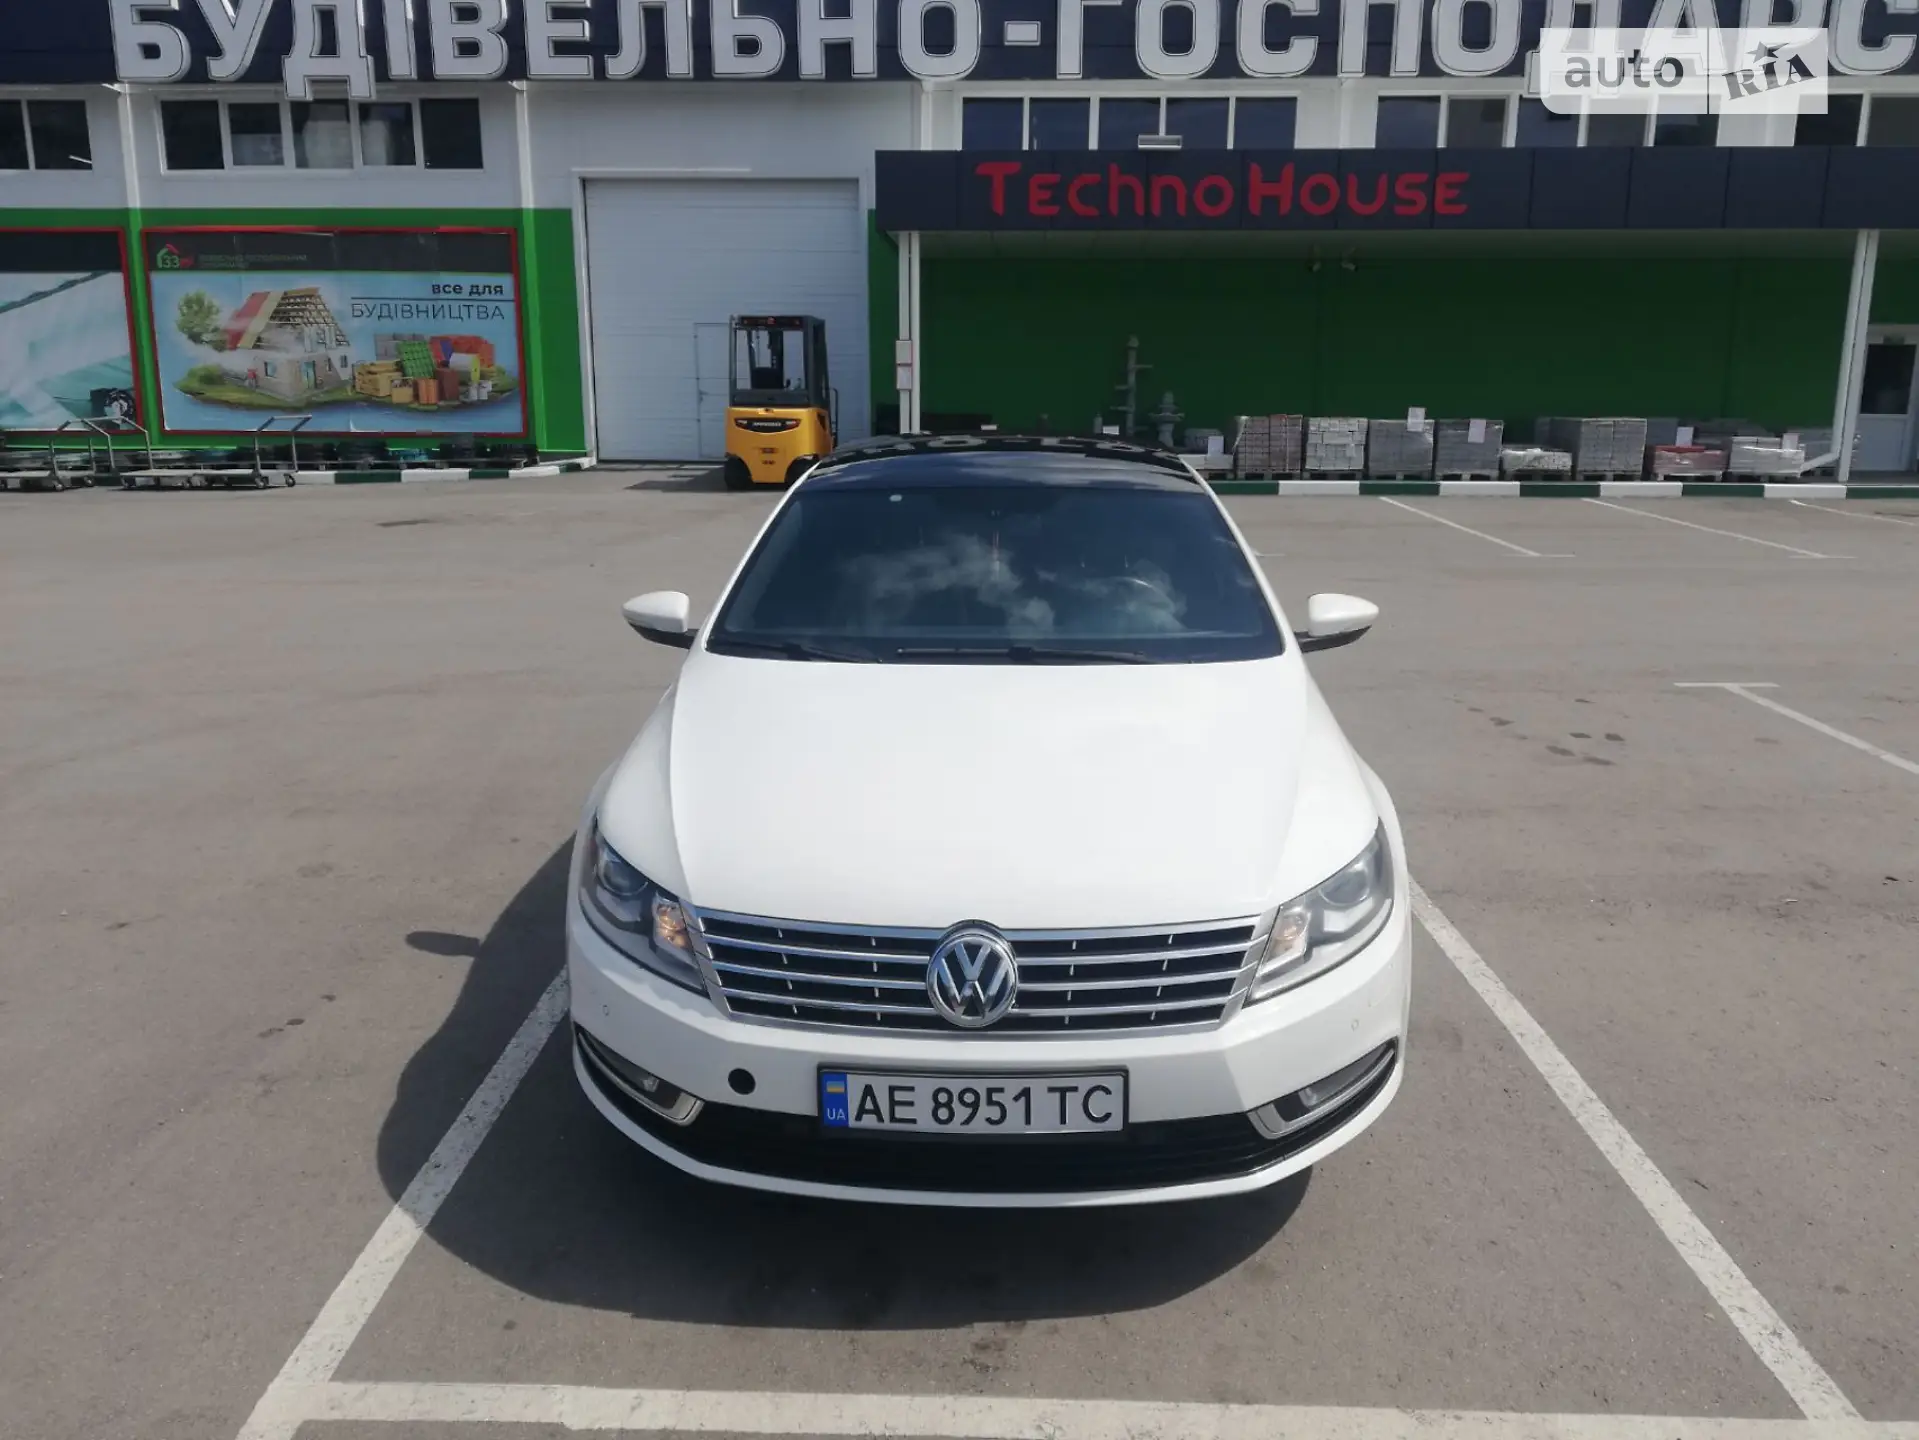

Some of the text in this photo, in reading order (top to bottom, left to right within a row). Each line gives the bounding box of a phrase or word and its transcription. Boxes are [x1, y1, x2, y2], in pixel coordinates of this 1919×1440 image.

[431, 283, 505, 297] все для
[351, 303, 506, 322] БУДІВНИЦТВА
[854, 1083, 1113, 1126] AE 8951 TC
[827, 1107, 847, 1121] UA
